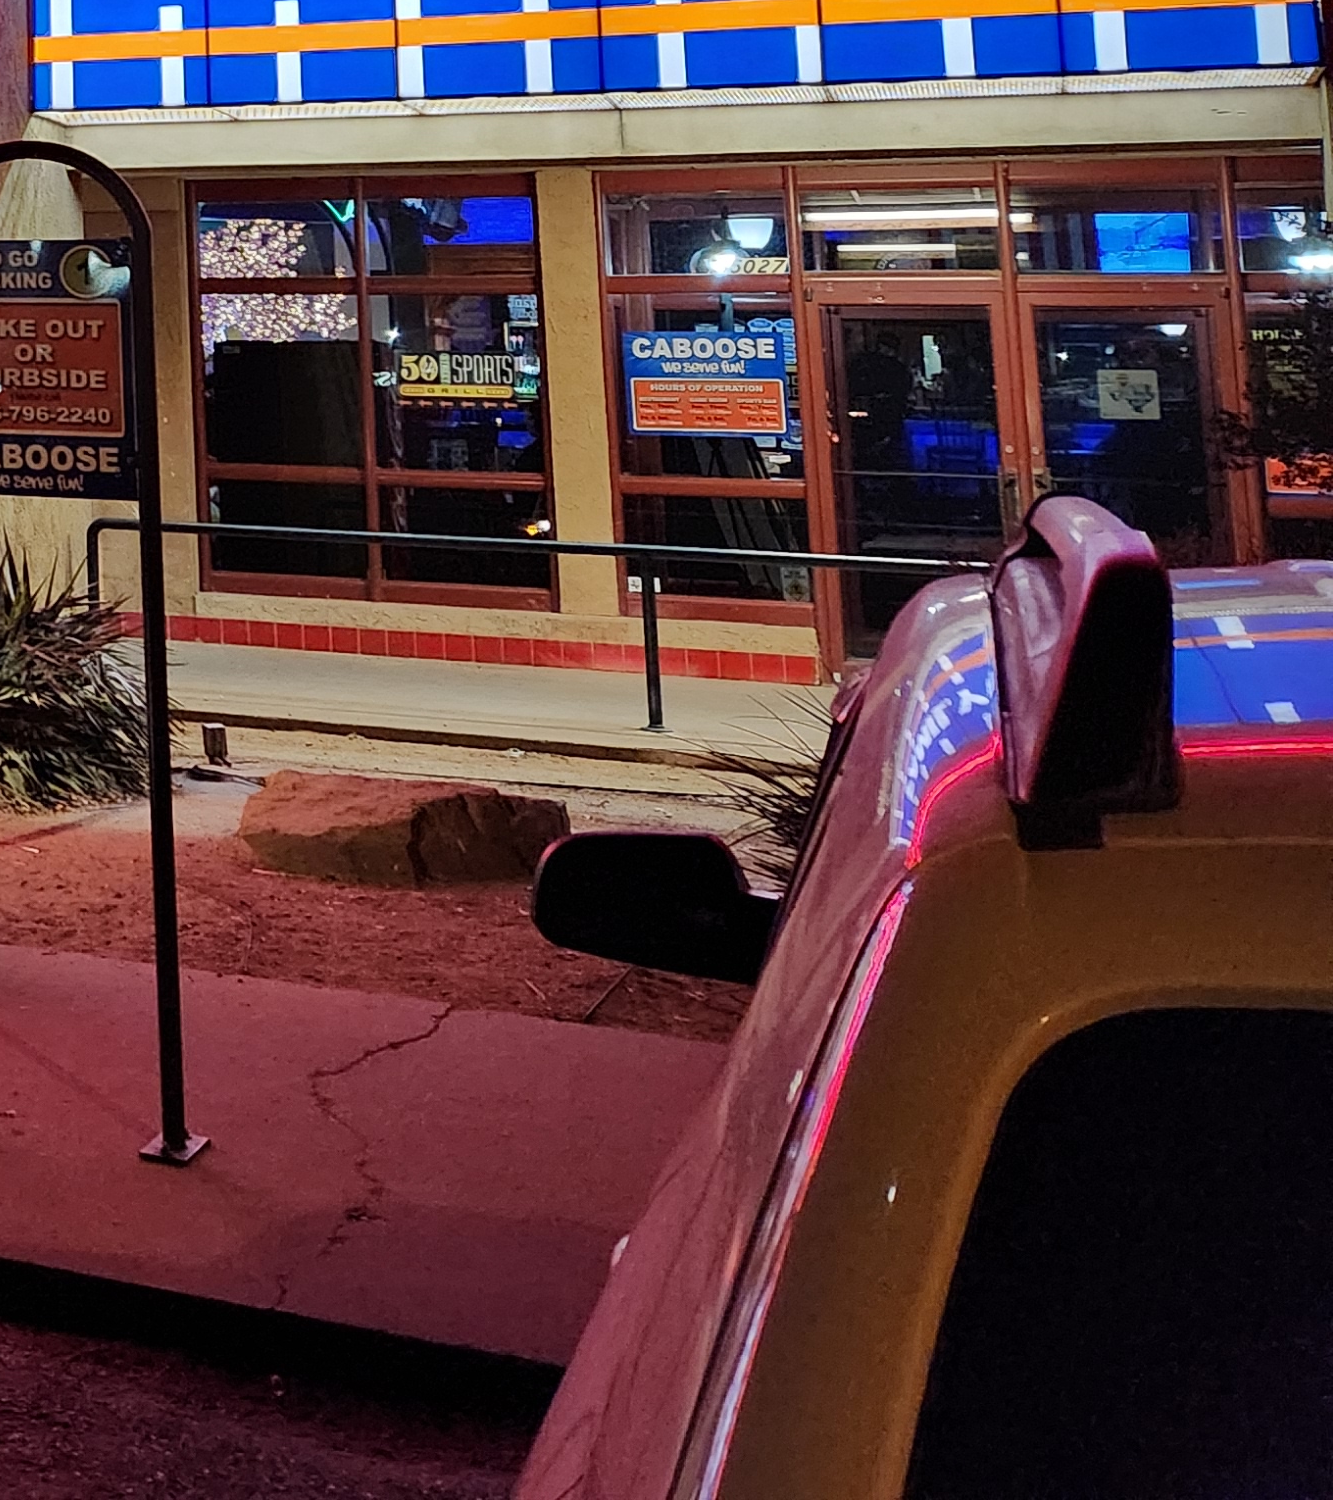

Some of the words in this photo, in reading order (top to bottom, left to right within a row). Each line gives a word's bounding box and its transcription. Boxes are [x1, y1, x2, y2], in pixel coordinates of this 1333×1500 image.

[8, 251, 38, 267] GO
[45, 319, 104, 338] OUT
[14, 344, 54, 362] OR
[632, 337, 776, 359] CABOOSE
[452, 354, 513, 384] SPORTS
[684, 362, 719, 374] serve
[721, 360, 746, 374] fun!
[687, 384, 702, 392] OF
[704, 384, 763, 393] OPERATION
[15, 474, 53, 490] serve
[56, 473, 85, 492] fun!
